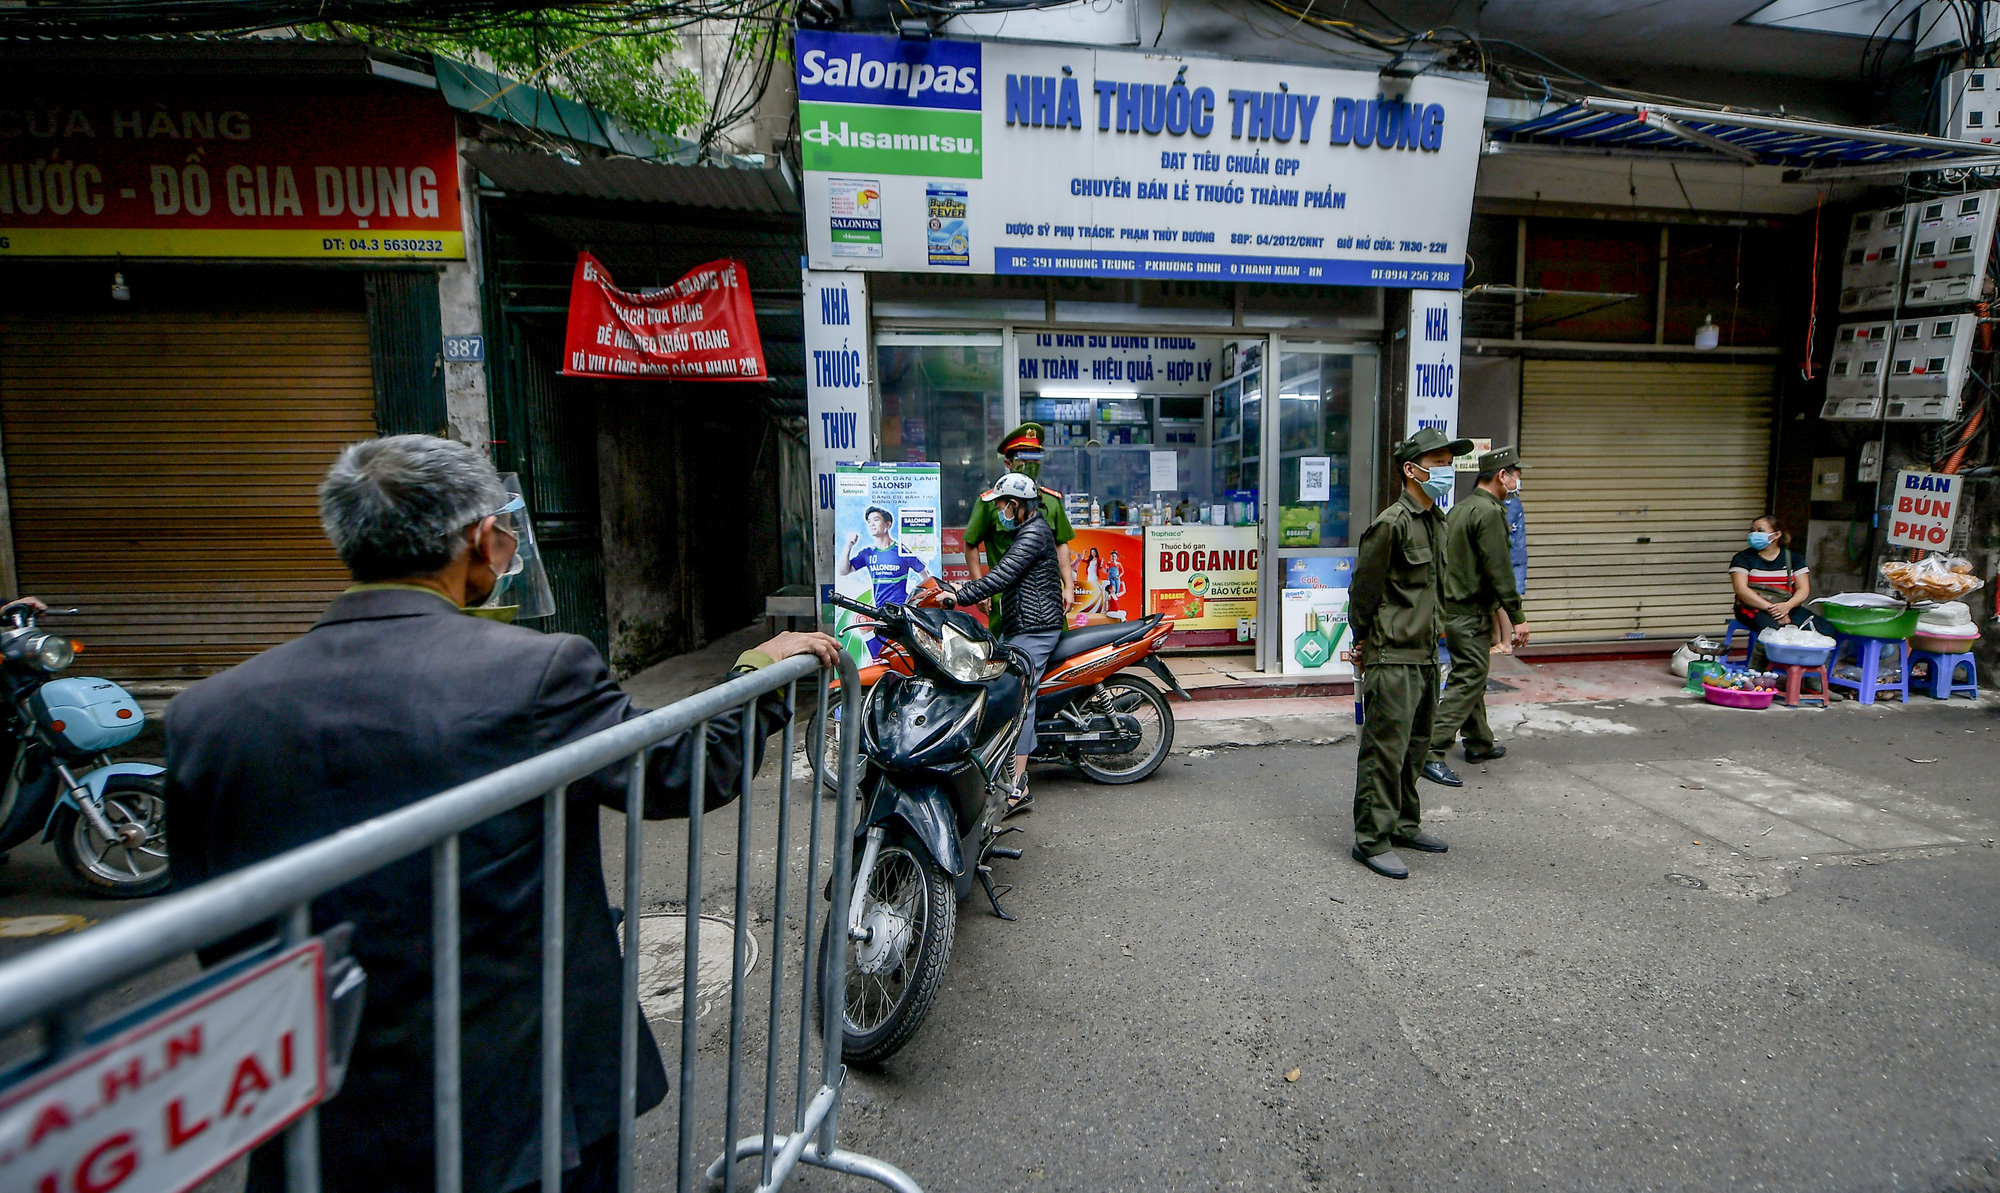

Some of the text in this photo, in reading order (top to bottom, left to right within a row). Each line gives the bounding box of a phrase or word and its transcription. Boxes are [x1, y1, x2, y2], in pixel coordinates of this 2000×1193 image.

[801, 49, 976, 98] Salonpas
[113, 103, 251, 140] HÀNG
[1006, 65, 1446, 152] NHÀ THUỐC THÙY DƯƠNG
[1161, 148, 1300, 176] ĐẠT TIÊU CHUẨN GPP
[150, 147, 211, 217] ĐỒ
[226, 165, 303, 217] GIA
[315, 165, 440, 229] DỤNG
[1070, 176, 1131, 198] CHUYÊN
[1138, 178, 1168, 200] BÁN
[1195, 179, 1245, 204] THUỐC
[1251, 185, 1299, 208] THÀNH
[1304, 184, 1347, 209] PHẨM
[350, 239, 379, 251] 04.3
[383, 239, 443, 252] 5630232
[1033, 256, 1053, 268] 391
[1309, 266, 1323, 277] HN
[1410, 270, 1430, 281] 256
[1431, 271, 1451, 282] 288
[672, 301, 704, 324] HÀNG
[820, 281, 850, 326] NHÀ
[1425, 302, 1448, 342] NHÀ
[448, 339, 480, 357] 387
[691, 328, 730, 351] TRANG
[813, 338, 861, 388] THUỐC
[1019, 358, 1038, 379] AN
[1042, 355, 1078, 380] TOÀN
[1093, 357, 1122, 385] HIỆU
[1127, 354, 1154, 383] QUẢ
[1167, 359, 1193, 386] HỢP
[1198, 358, 1212, 382] LÝ
[1416, 353, 1453, 398] THUỐC
[821, 407, 857, 449] THÙY
[1904, 473, 1951, 493] BÁN
[1897, 495, 1951, 518] BÚN
[1893, 522, 1949, 544] PHỞ
[1160, 549, 1258, 572] BOGANIC
